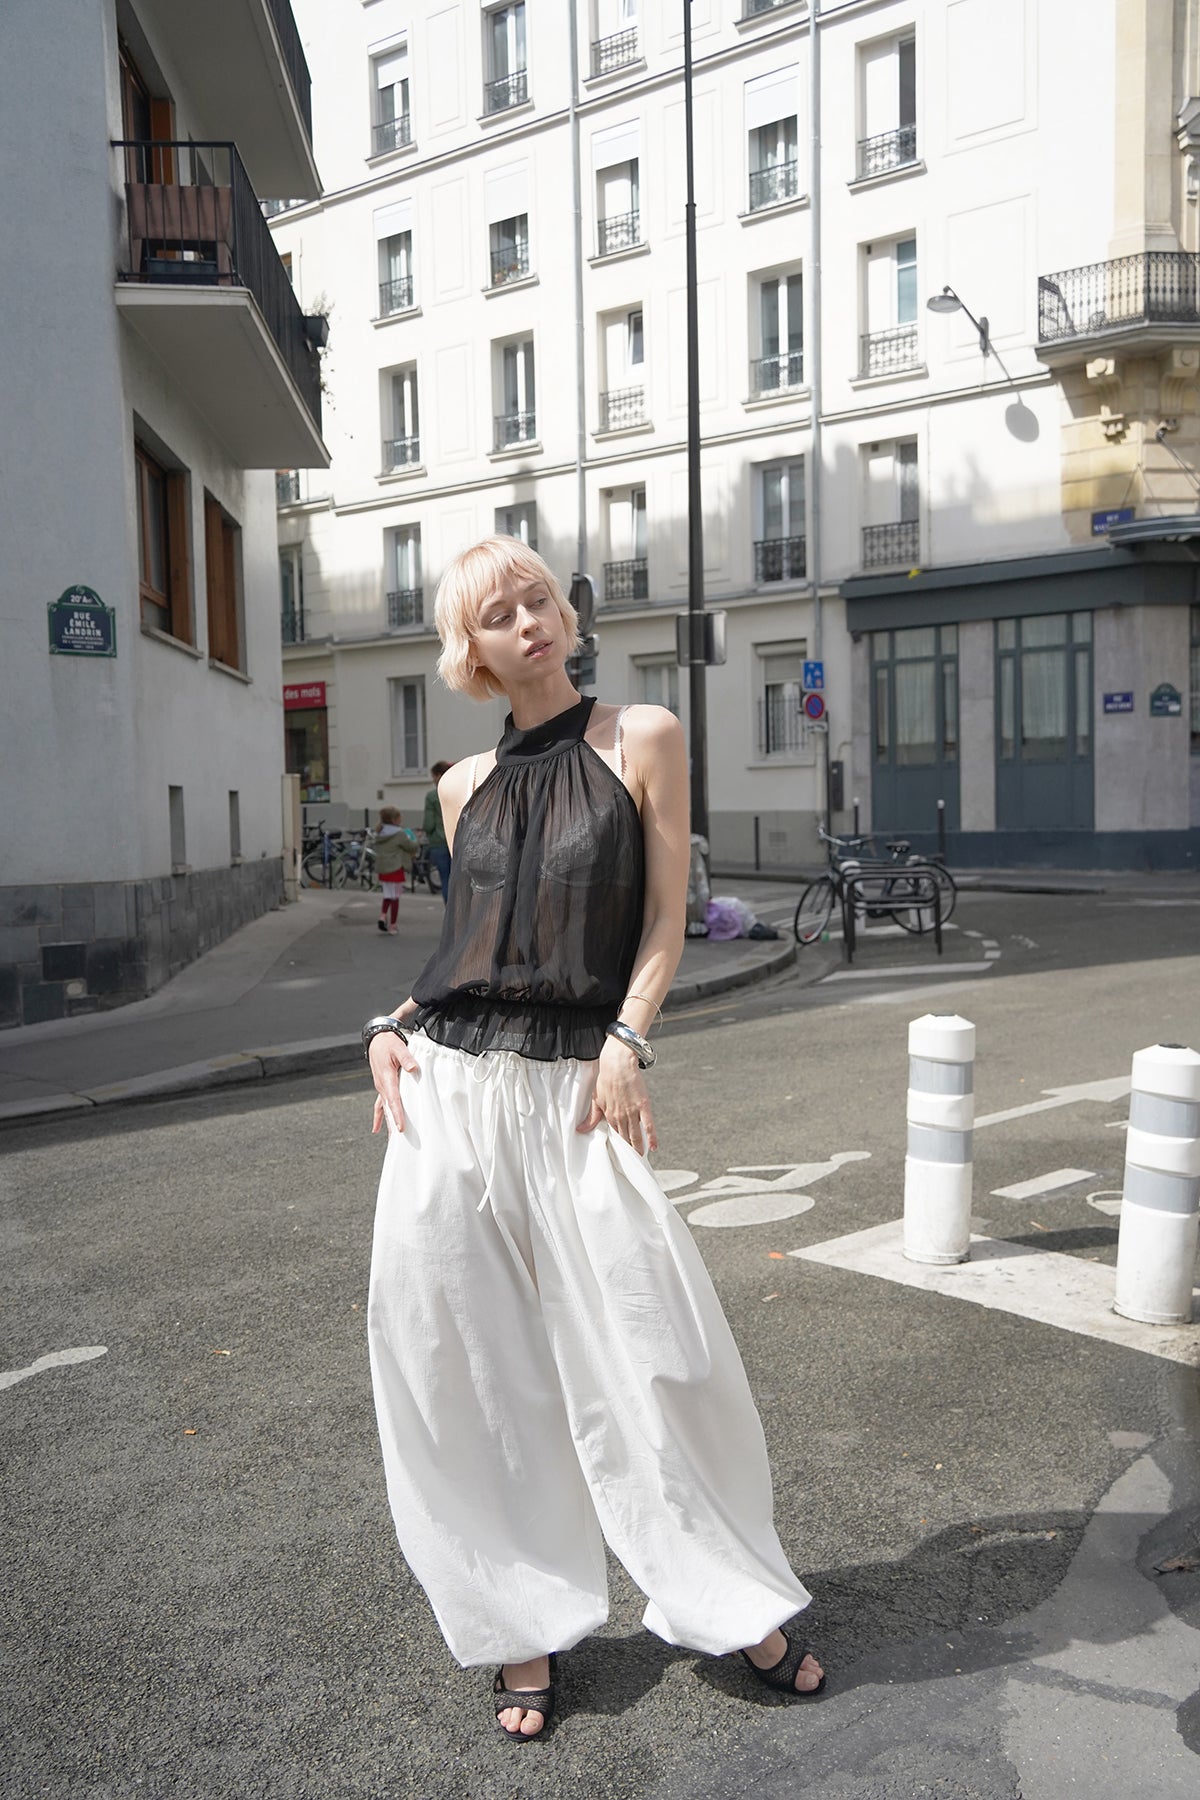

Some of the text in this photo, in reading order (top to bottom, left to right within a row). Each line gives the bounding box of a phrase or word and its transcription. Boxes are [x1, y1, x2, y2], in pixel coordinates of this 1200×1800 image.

[73, 612, 91, 620] RUE
[69, 618, 96, 628] ÉMILE
[64, 627, 102, 636] LANDRIN
[285, 688, 299, 700] des
